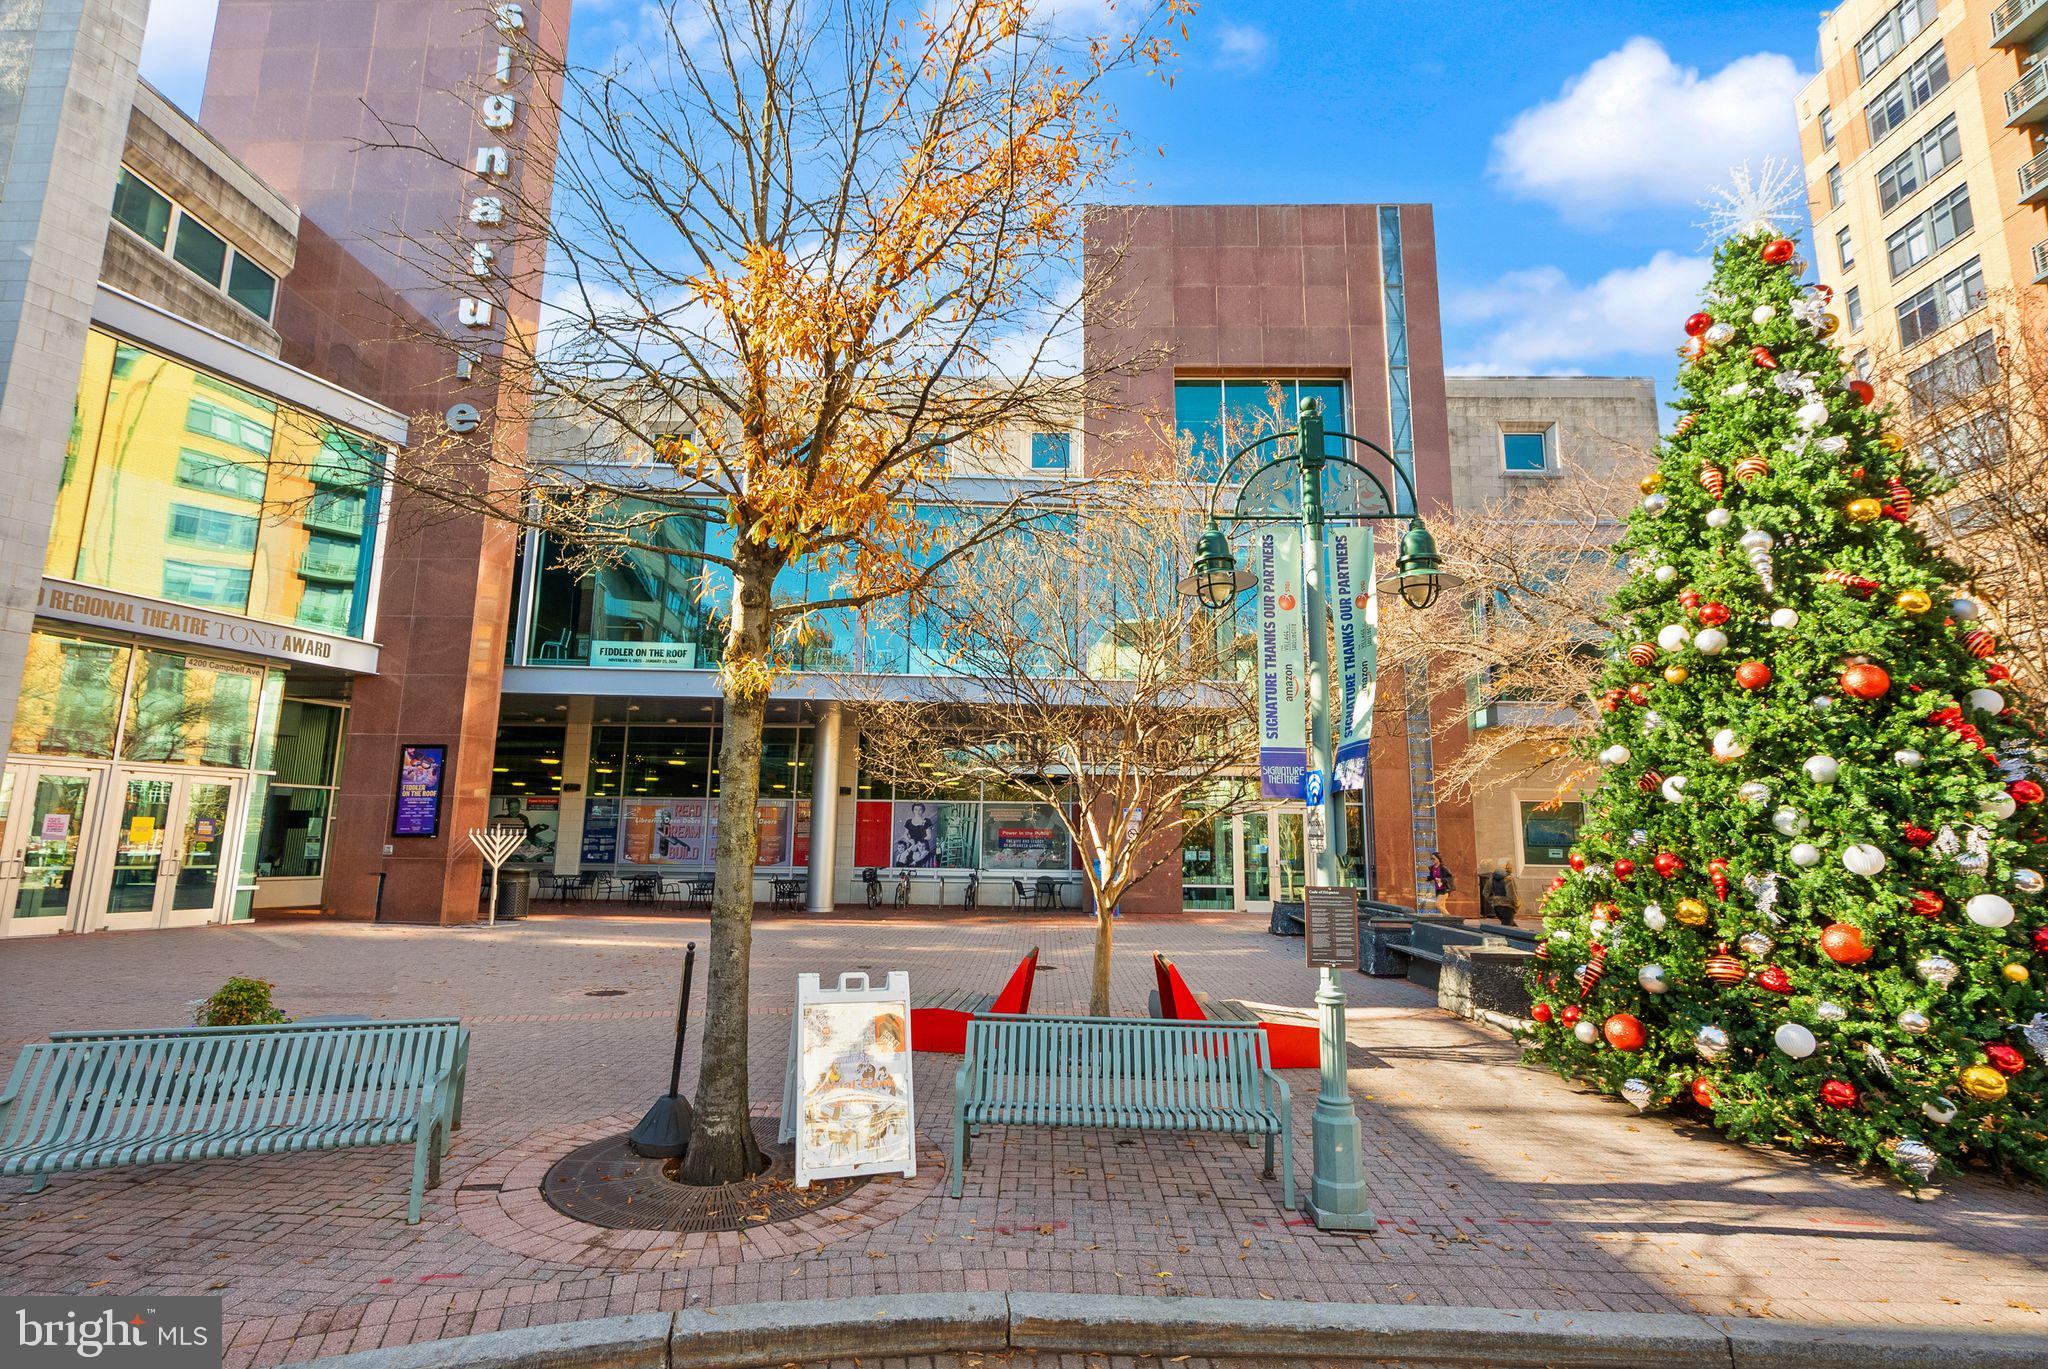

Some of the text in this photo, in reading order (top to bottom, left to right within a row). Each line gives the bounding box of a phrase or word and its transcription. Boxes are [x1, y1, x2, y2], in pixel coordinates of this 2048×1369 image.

[49, 589, 135, 623] REGIONAL
[142, 606, 210, 637] THEATRE
[214, 621, 281, 649] TONY
[282, 635, 331, 659] AWARD
[1262, 534, 1279, 739] SIGNATURE THANKS OUR PARTNERS
[1335, 535, 1356, 738] SIGNATURE THANKS OUR PARTNERS
[600, 647, 688, 658] FIDDLER ON THE ROOF
[188, 658, 262, 677] 4200 Campbell Ave.
[1285, 664, 1294, 702] amazon
[1361, 660, 1369, 692] mazon
[1262, 765, 1305, 776] SIGNATURE
[1267, 775, 1300, 785] THEATRE
[674, 804, 702, 818] READ
[664, 817, 681, 825] Open
[663, 824, 701, 839] DREAM
[668, 847, 699, 860] BUILD
